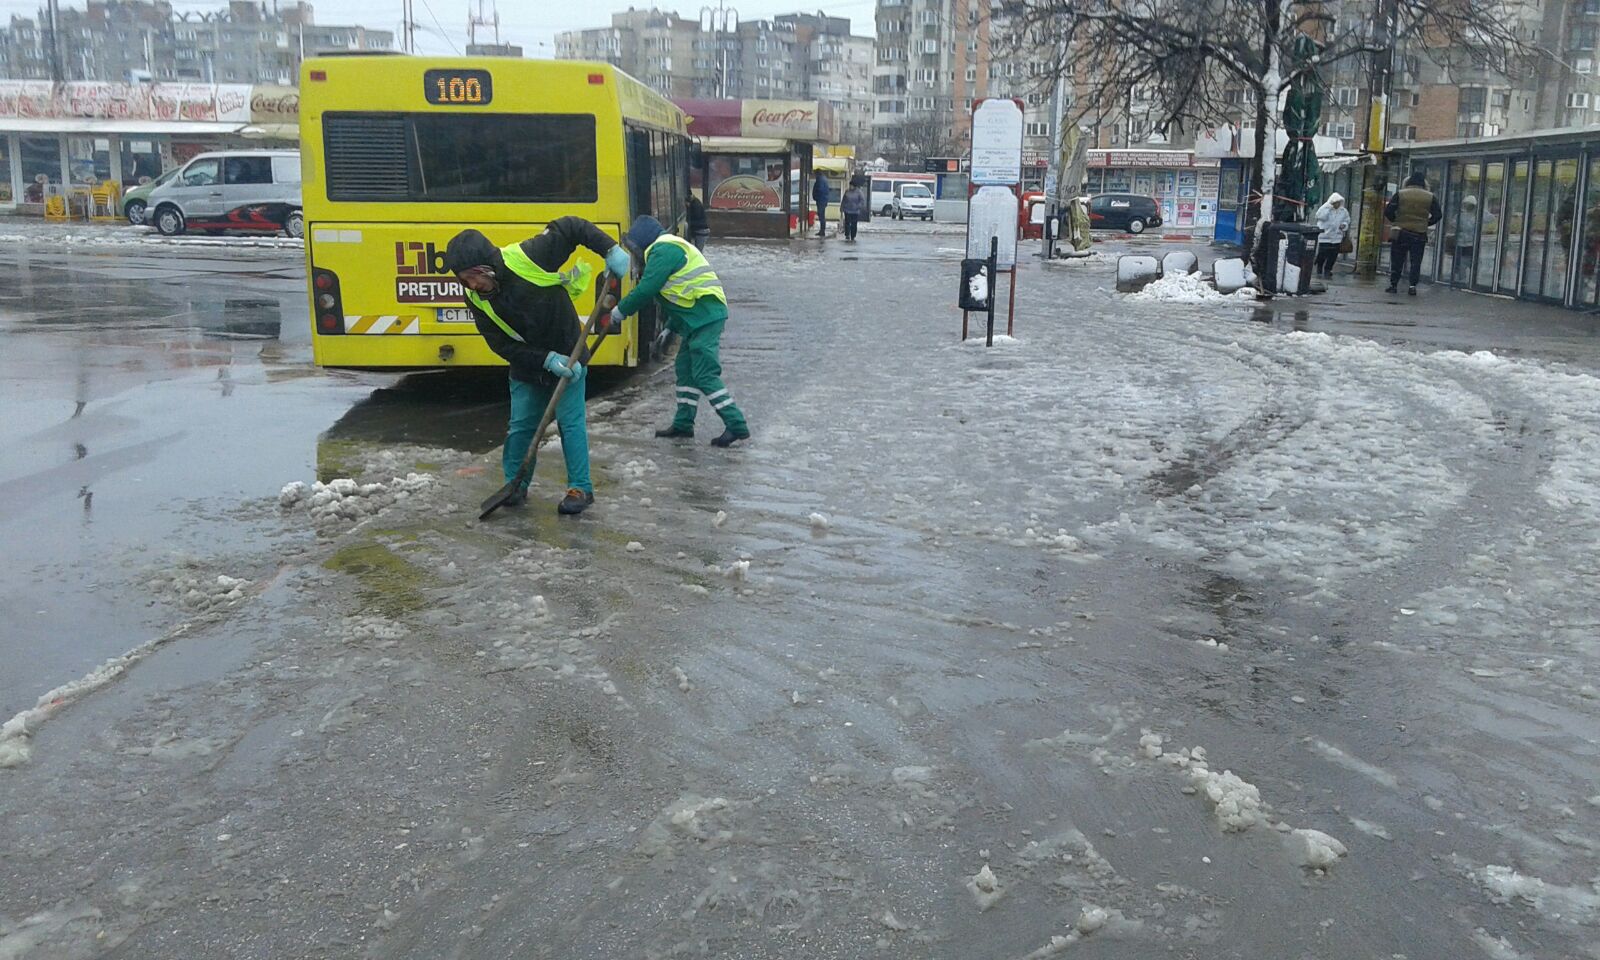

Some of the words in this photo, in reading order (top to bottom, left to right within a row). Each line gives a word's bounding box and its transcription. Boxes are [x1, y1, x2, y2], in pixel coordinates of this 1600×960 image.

[437, 77, 482, 103] 100
[250, 94, 300, 113] Coca-Col
[395, 241, 450, 275] Lib
[445, 309, 461, 321] CT
